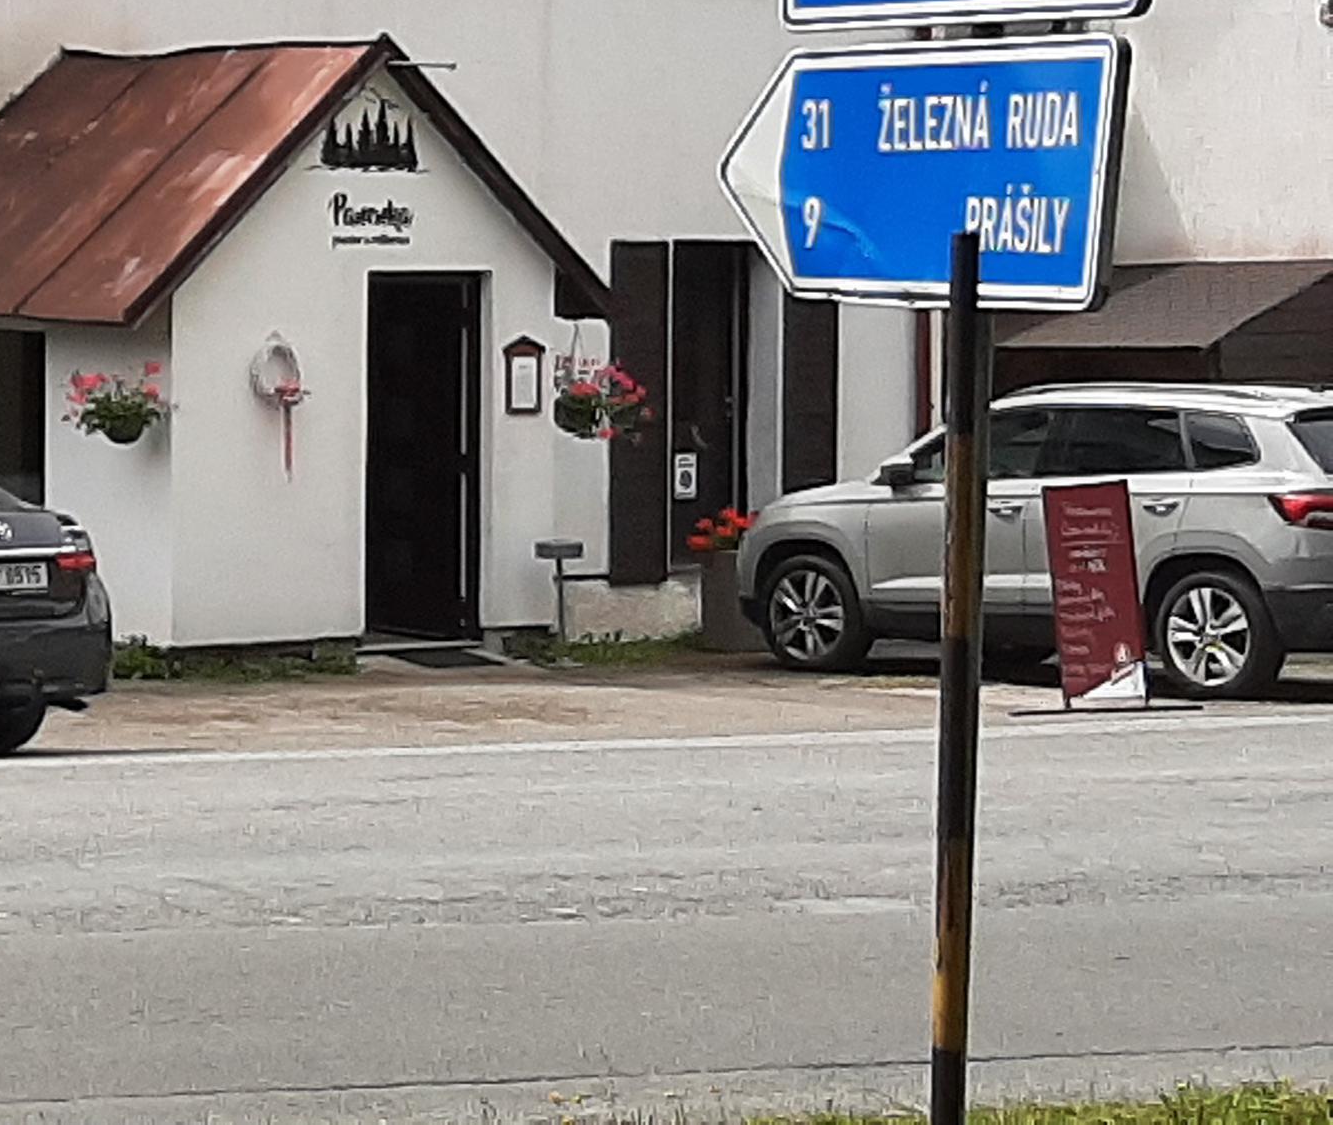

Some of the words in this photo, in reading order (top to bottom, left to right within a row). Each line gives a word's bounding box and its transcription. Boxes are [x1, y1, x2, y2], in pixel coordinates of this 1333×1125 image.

[801, 98, 831, 151] 31
[878, 81, 990, 153] ŽELEZNÁ
[1005, 91, 1079, 149] RUDA
[802, 196, 822, 250] 9
[965, 183, 1071, 254] PRÁŠILY
